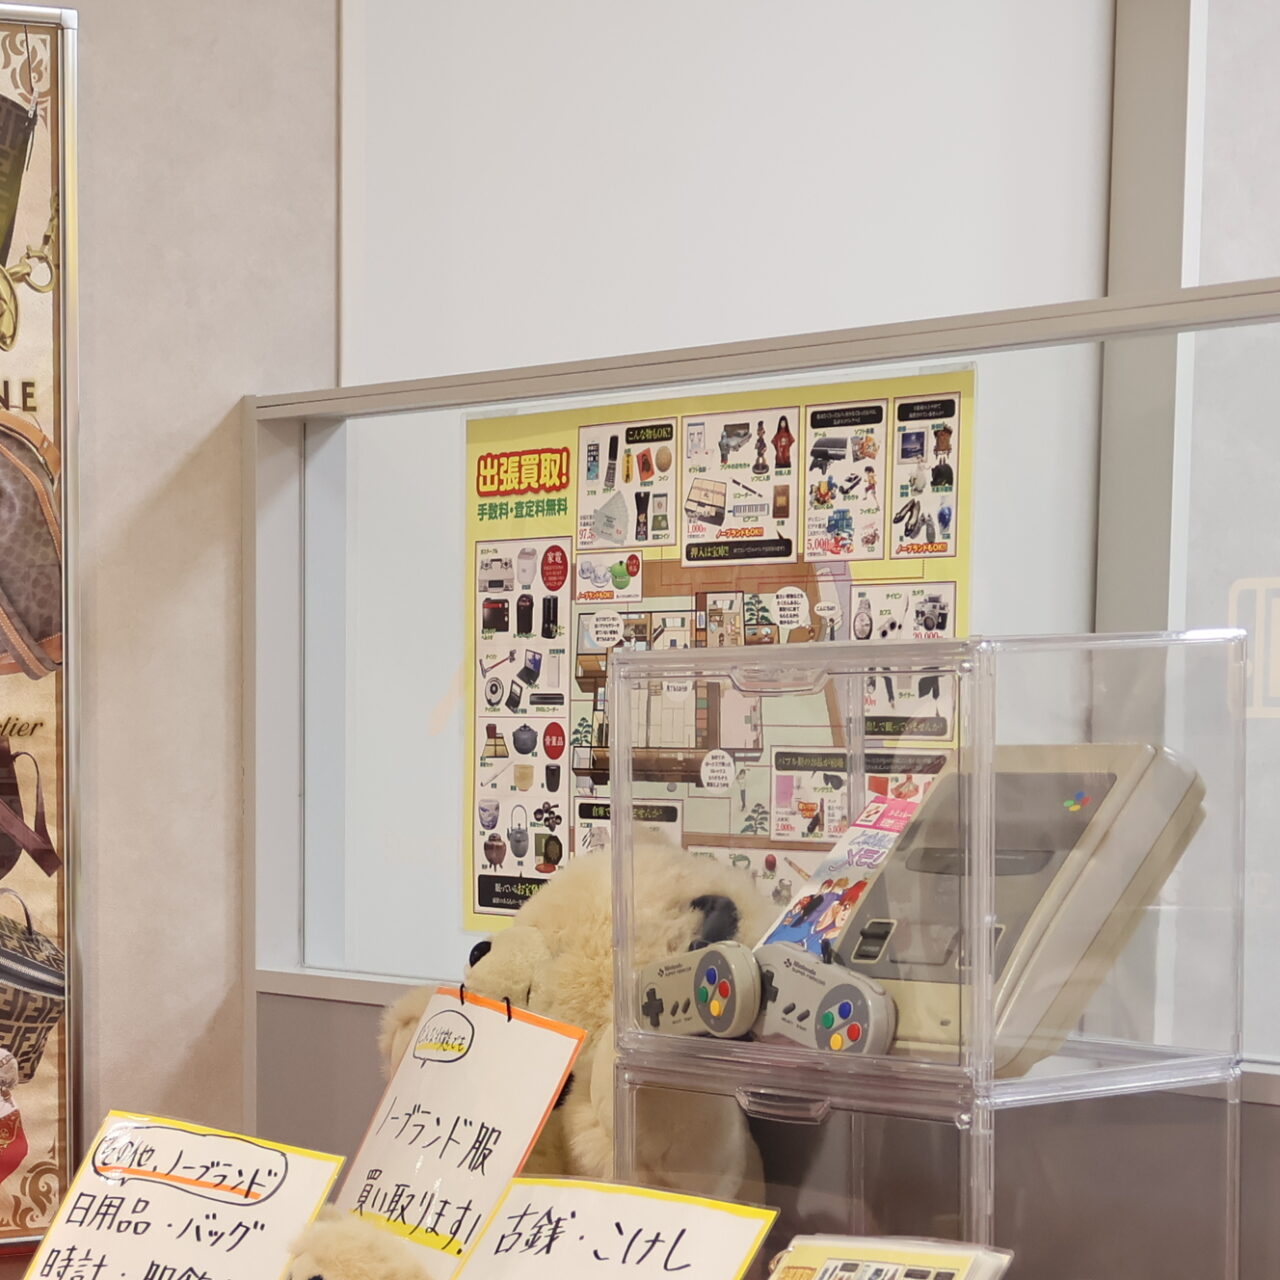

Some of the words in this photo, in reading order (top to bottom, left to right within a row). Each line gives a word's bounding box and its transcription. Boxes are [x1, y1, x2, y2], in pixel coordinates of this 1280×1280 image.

[478, 451, 568, 493] 出張買取!
[375, 1097, 502, 1176] ノーブランド服
[64, 1192, 266, 1252] 日用品・バッグ
[353, 1168, 483, 1256] 買い取ります!
[493, 1202, 693, 1272] 古銭・こけし
